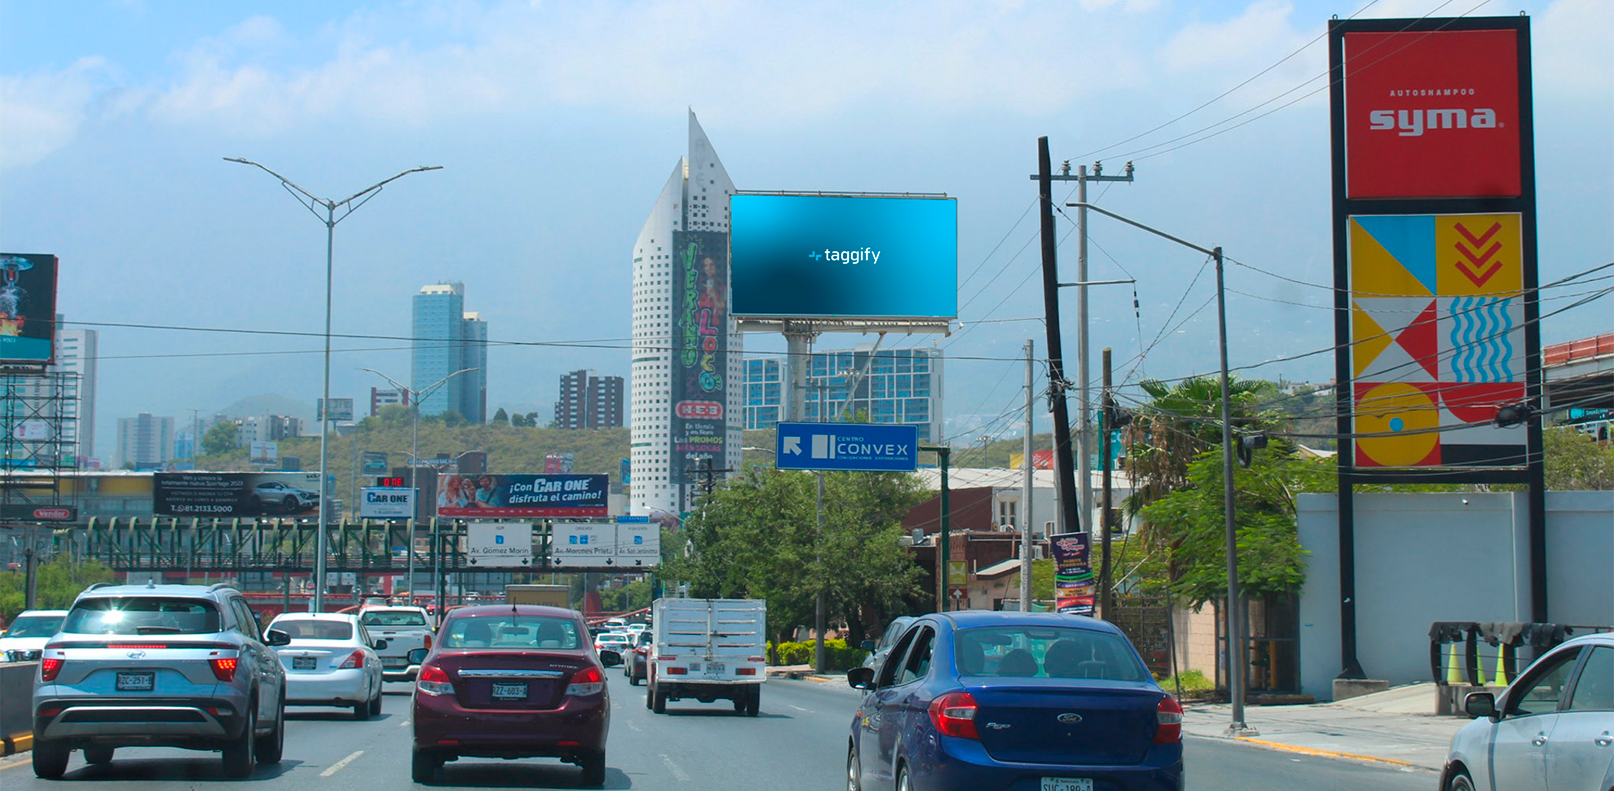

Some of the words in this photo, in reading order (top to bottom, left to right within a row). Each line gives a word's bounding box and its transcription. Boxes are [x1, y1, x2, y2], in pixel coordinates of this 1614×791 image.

[1390, 88, 1474, 96] AUTOSHAMPOO
[1370, 108, 1496, 136] syma
[824, 247, 880, 264] taggify
[678, 242, 698, 368] VERANO
[698, 308, 720, 392] LOCO
[837, 443, 908, 456] CONVEX
[510, 483, 532, 494] ¡Con
[534, 478, 561, 493] CAR
[564, 479, 589, 491] ONE
[367, 492, 388, 503] CAR
[509, 494, 547, 504] disfruta
[550, 492, 559, 501] el
[562, 490, 602, 501] camino!
